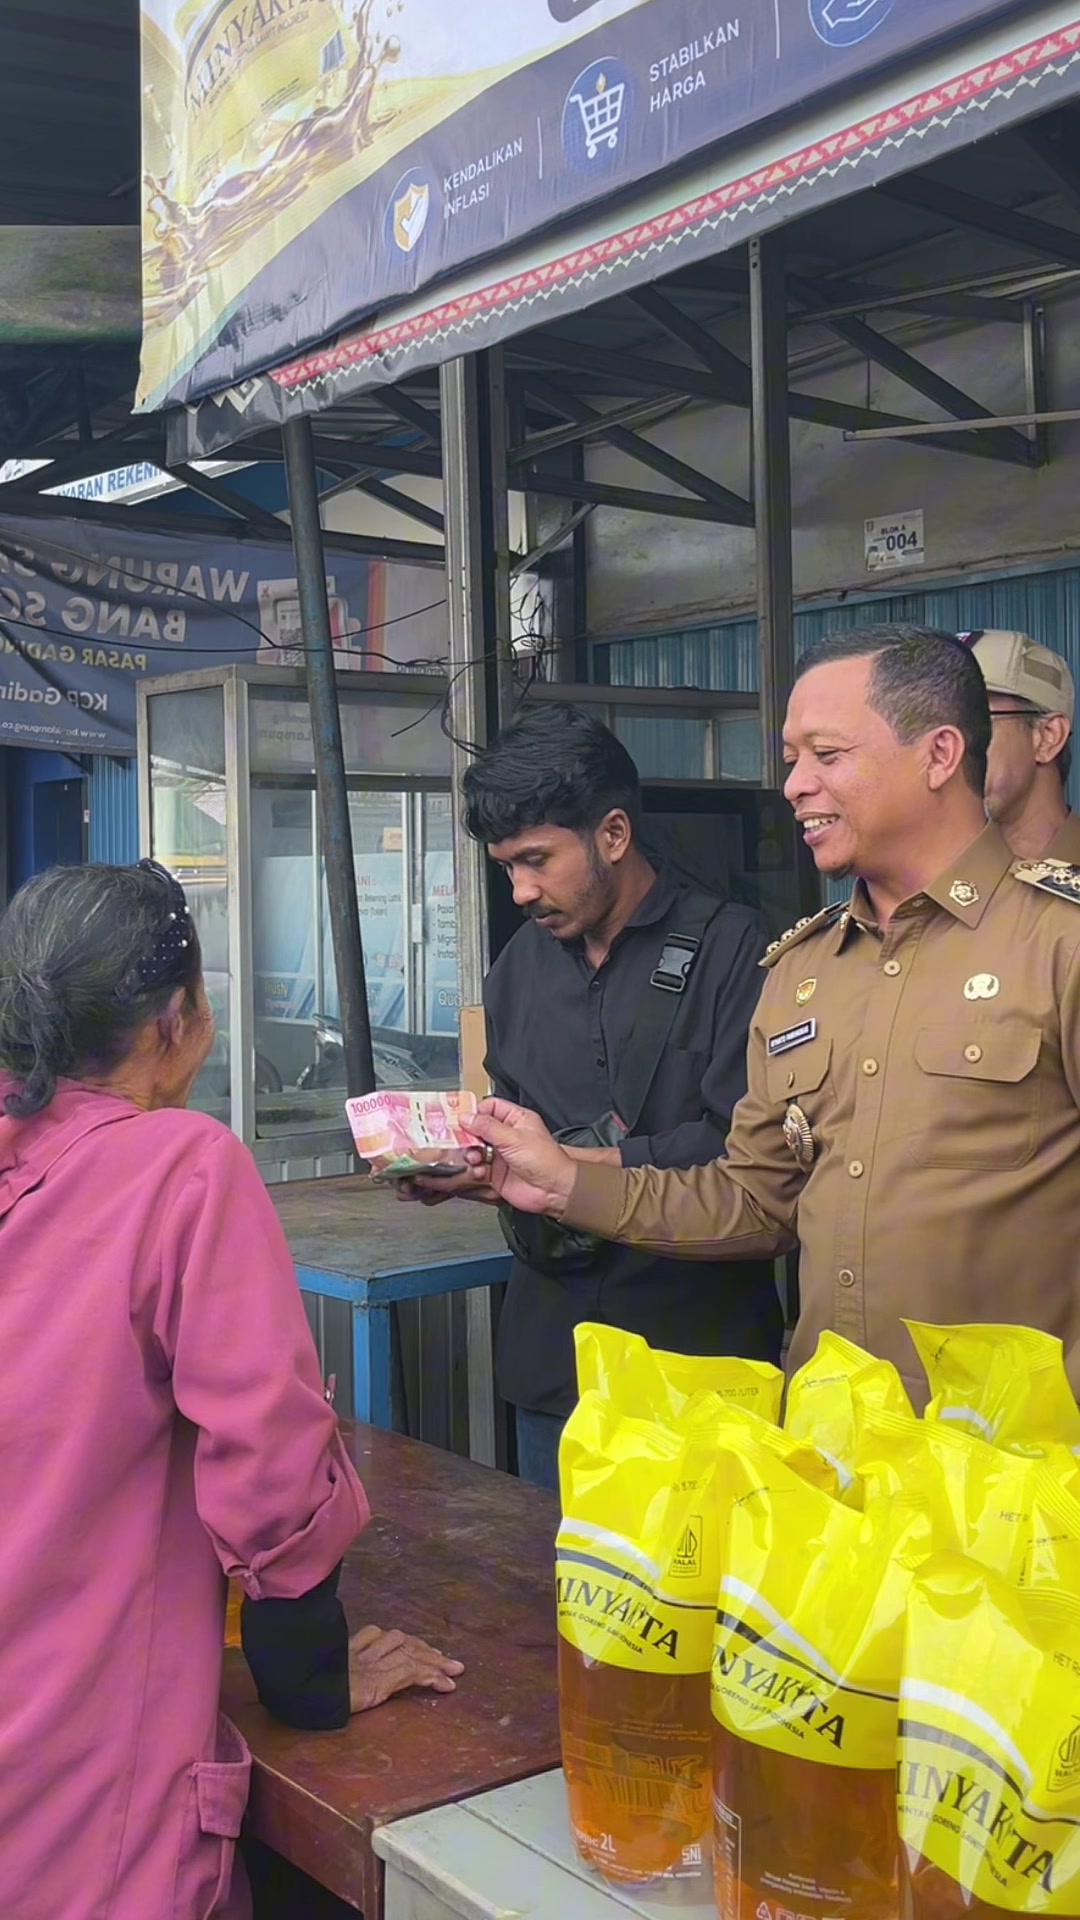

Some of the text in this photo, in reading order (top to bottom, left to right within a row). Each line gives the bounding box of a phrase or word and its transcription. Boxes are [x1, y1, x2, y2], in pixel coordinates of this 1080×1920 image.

[649, 19, 739, 82] STABILKAN
[649, 73, 706, 113] HARGA
[443, 138, 523, 192] KENDALIKAN
[443, 183, 490, 219] INFLASI
[886, 531, 918, 551] 004
[350, 1094, 392, 1114] 100000
[600, 1832, 617, 1853] 2L
[682, 1846, 702, 1861] SNI
